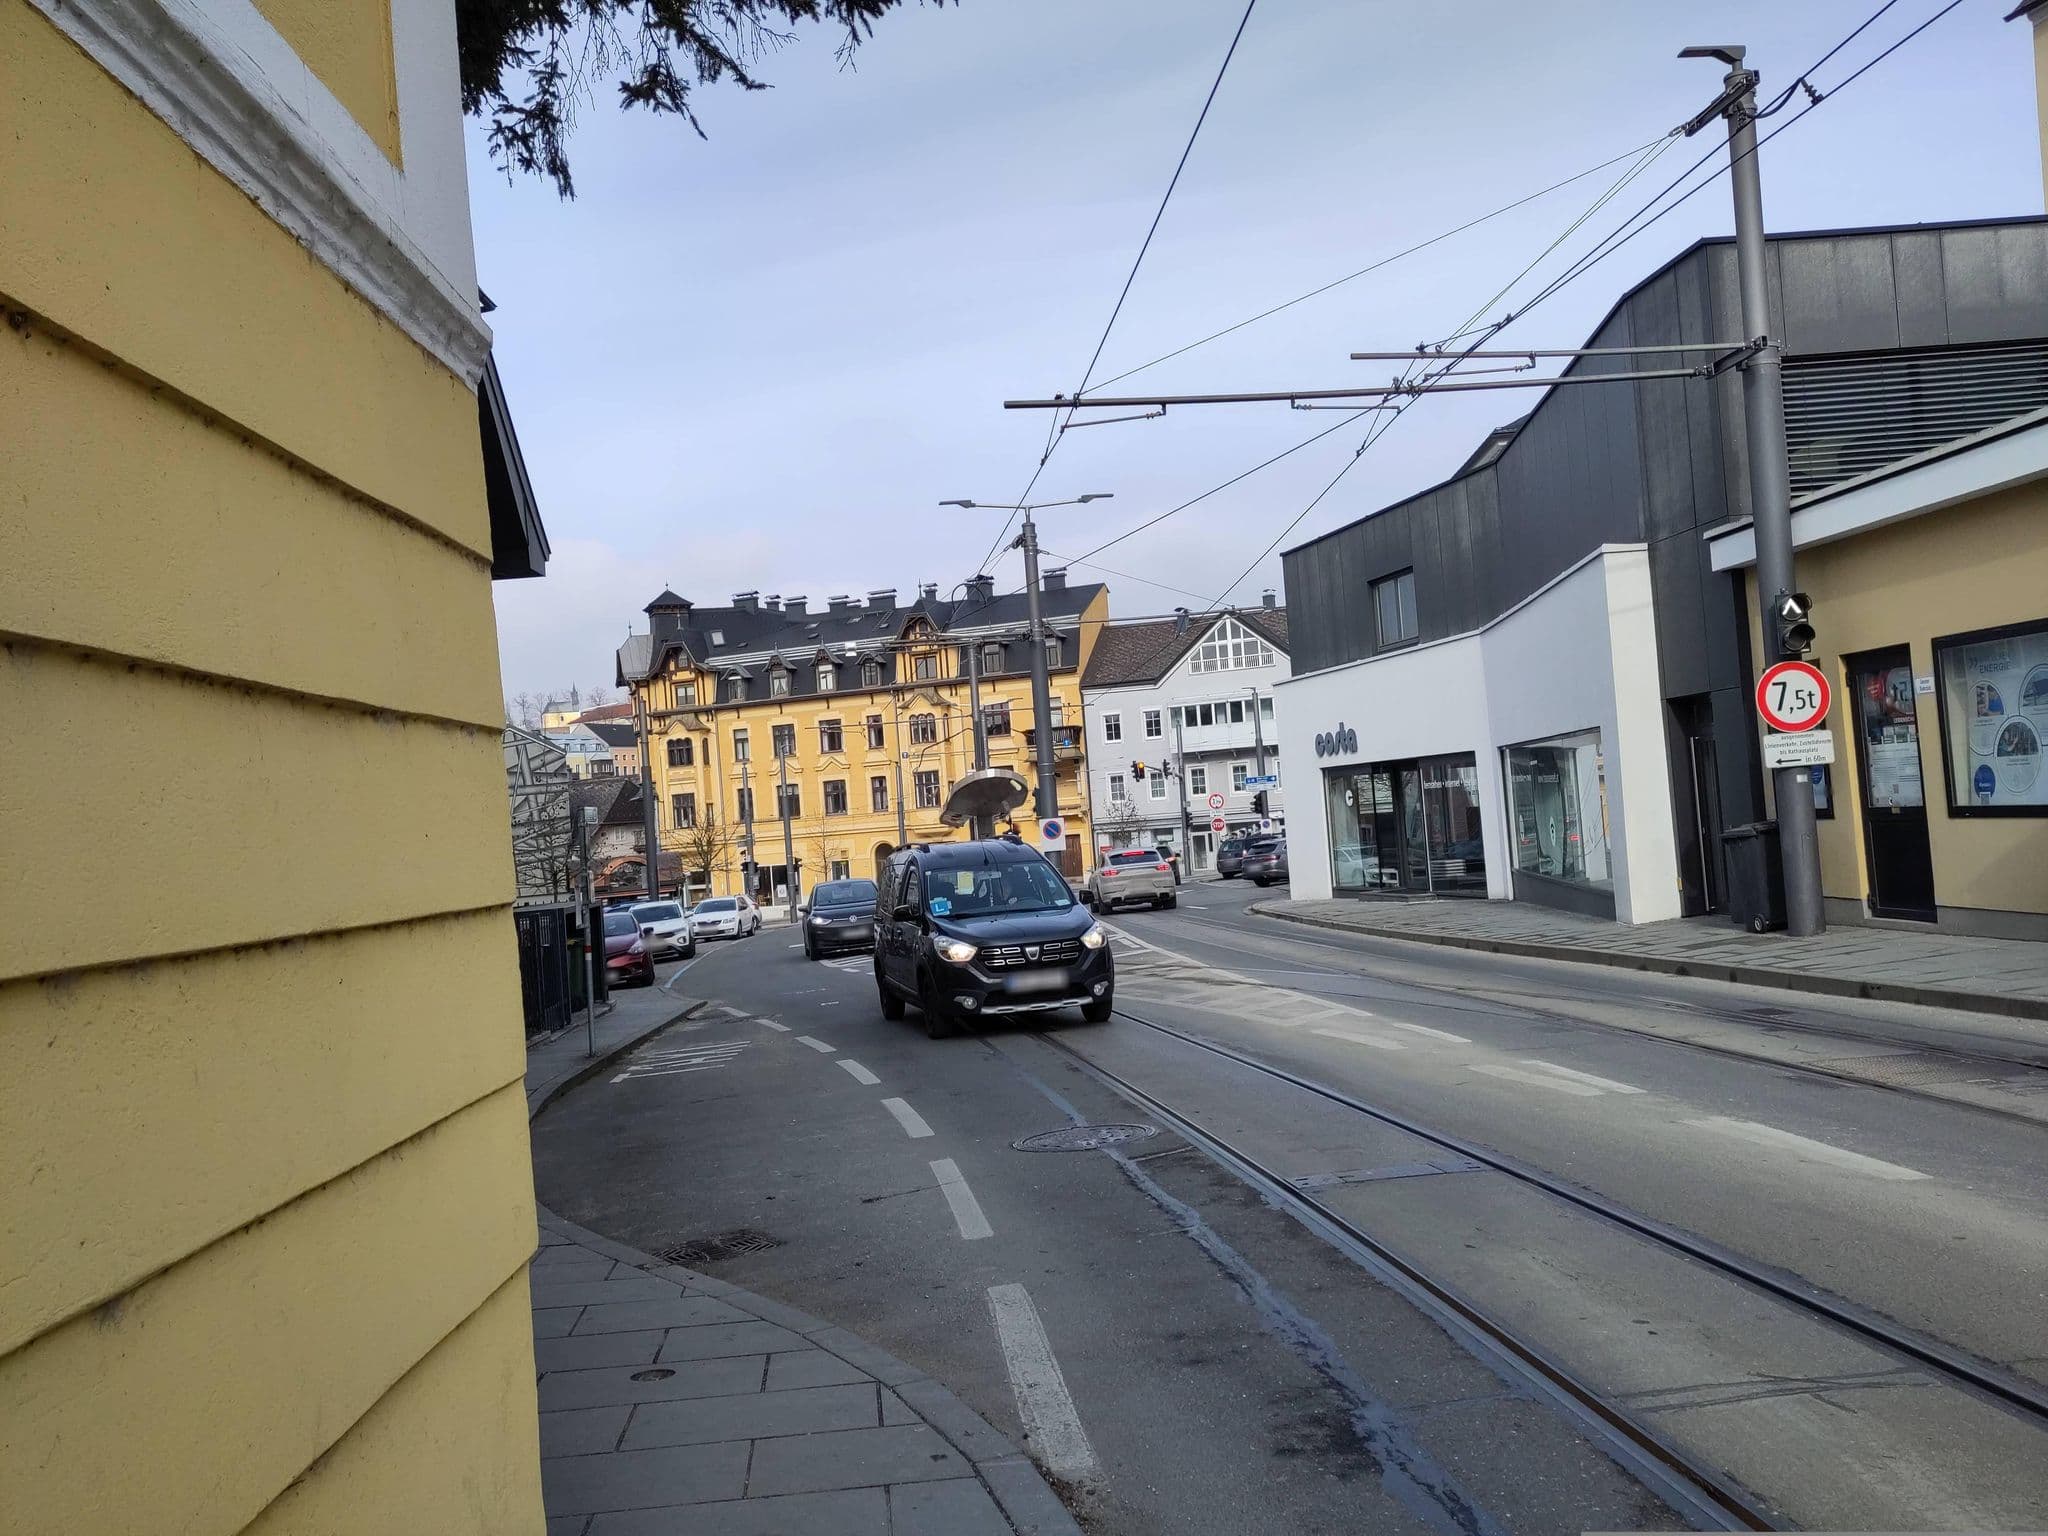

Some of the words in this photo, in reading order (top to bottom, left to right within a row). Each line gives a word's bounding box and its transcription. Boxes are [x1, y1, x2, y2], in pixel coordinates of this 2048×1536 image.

[1772, 682, 1817, 714] 7,5t
[1314, 721, 1358, 758] costa
[1212, 822, 1224, 830] STOP
